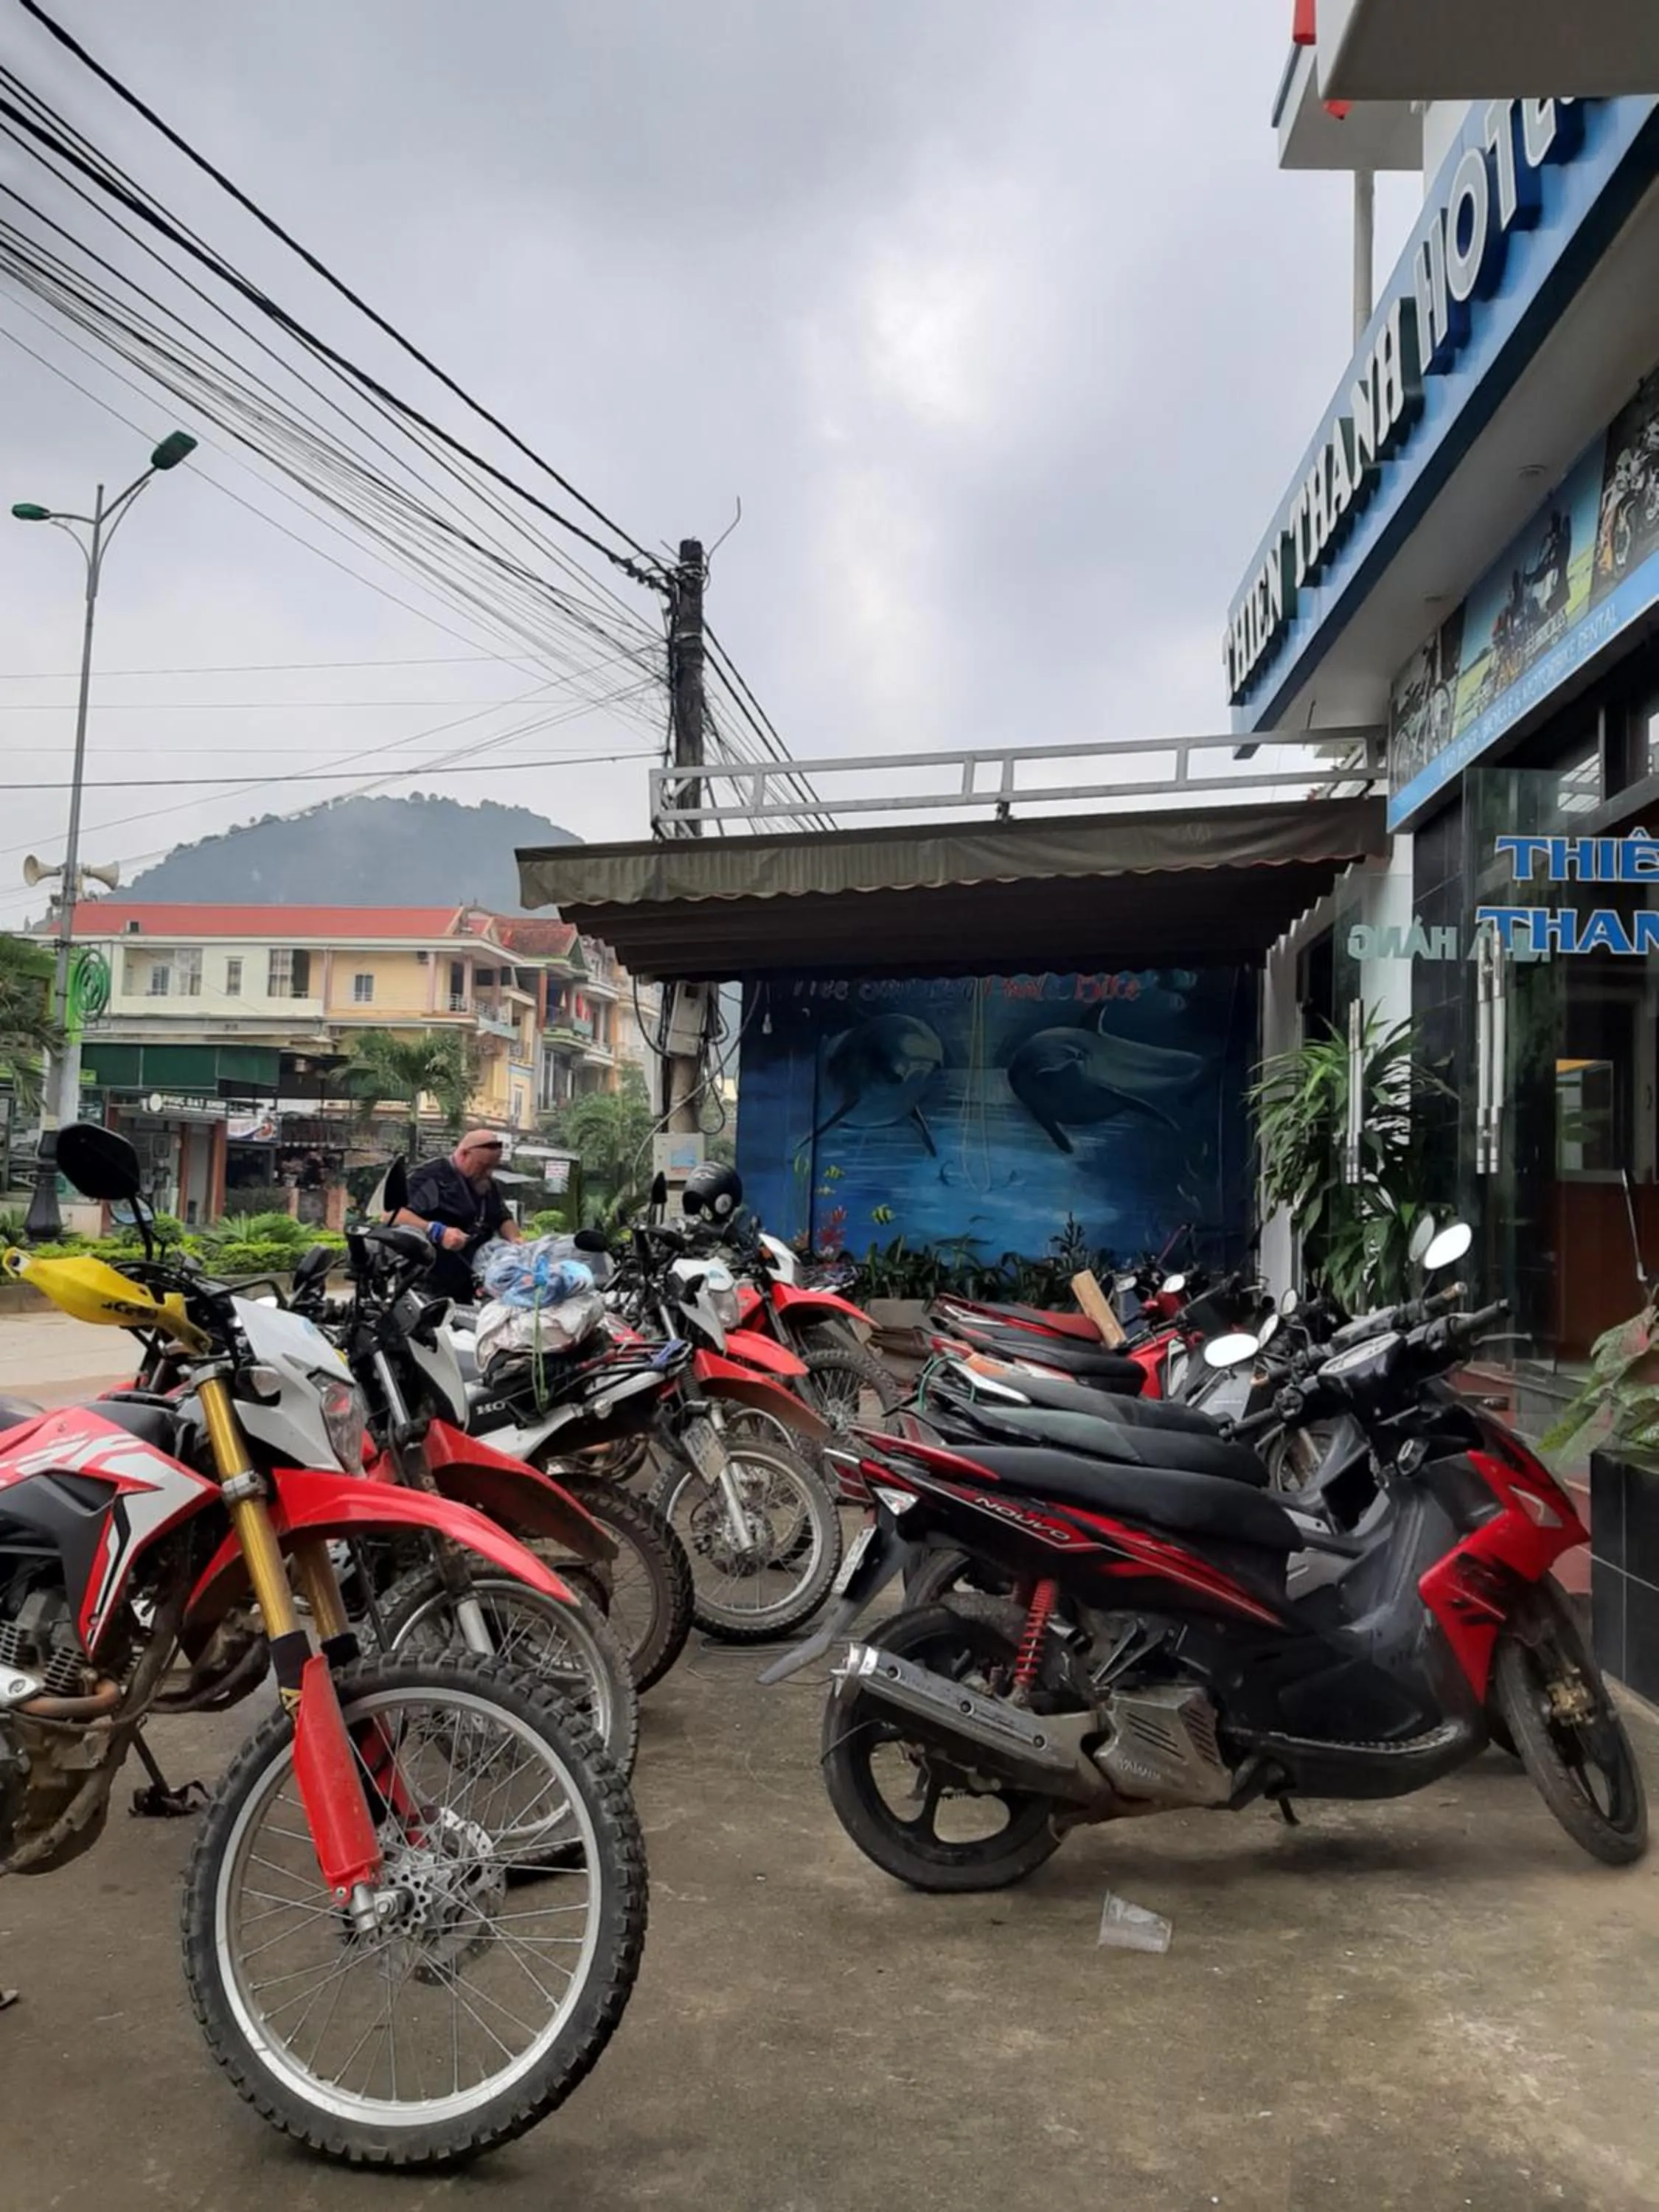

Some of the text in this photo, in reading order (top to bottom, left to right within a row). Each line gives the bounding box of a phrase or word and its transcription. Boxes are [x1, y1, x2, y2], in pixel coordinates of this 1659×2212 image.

[1222, 529, 1284, 697] THIEN
[1290, 298, 1405, 588] THANH
[974, 1497, 1071, 1540] NOUVO
